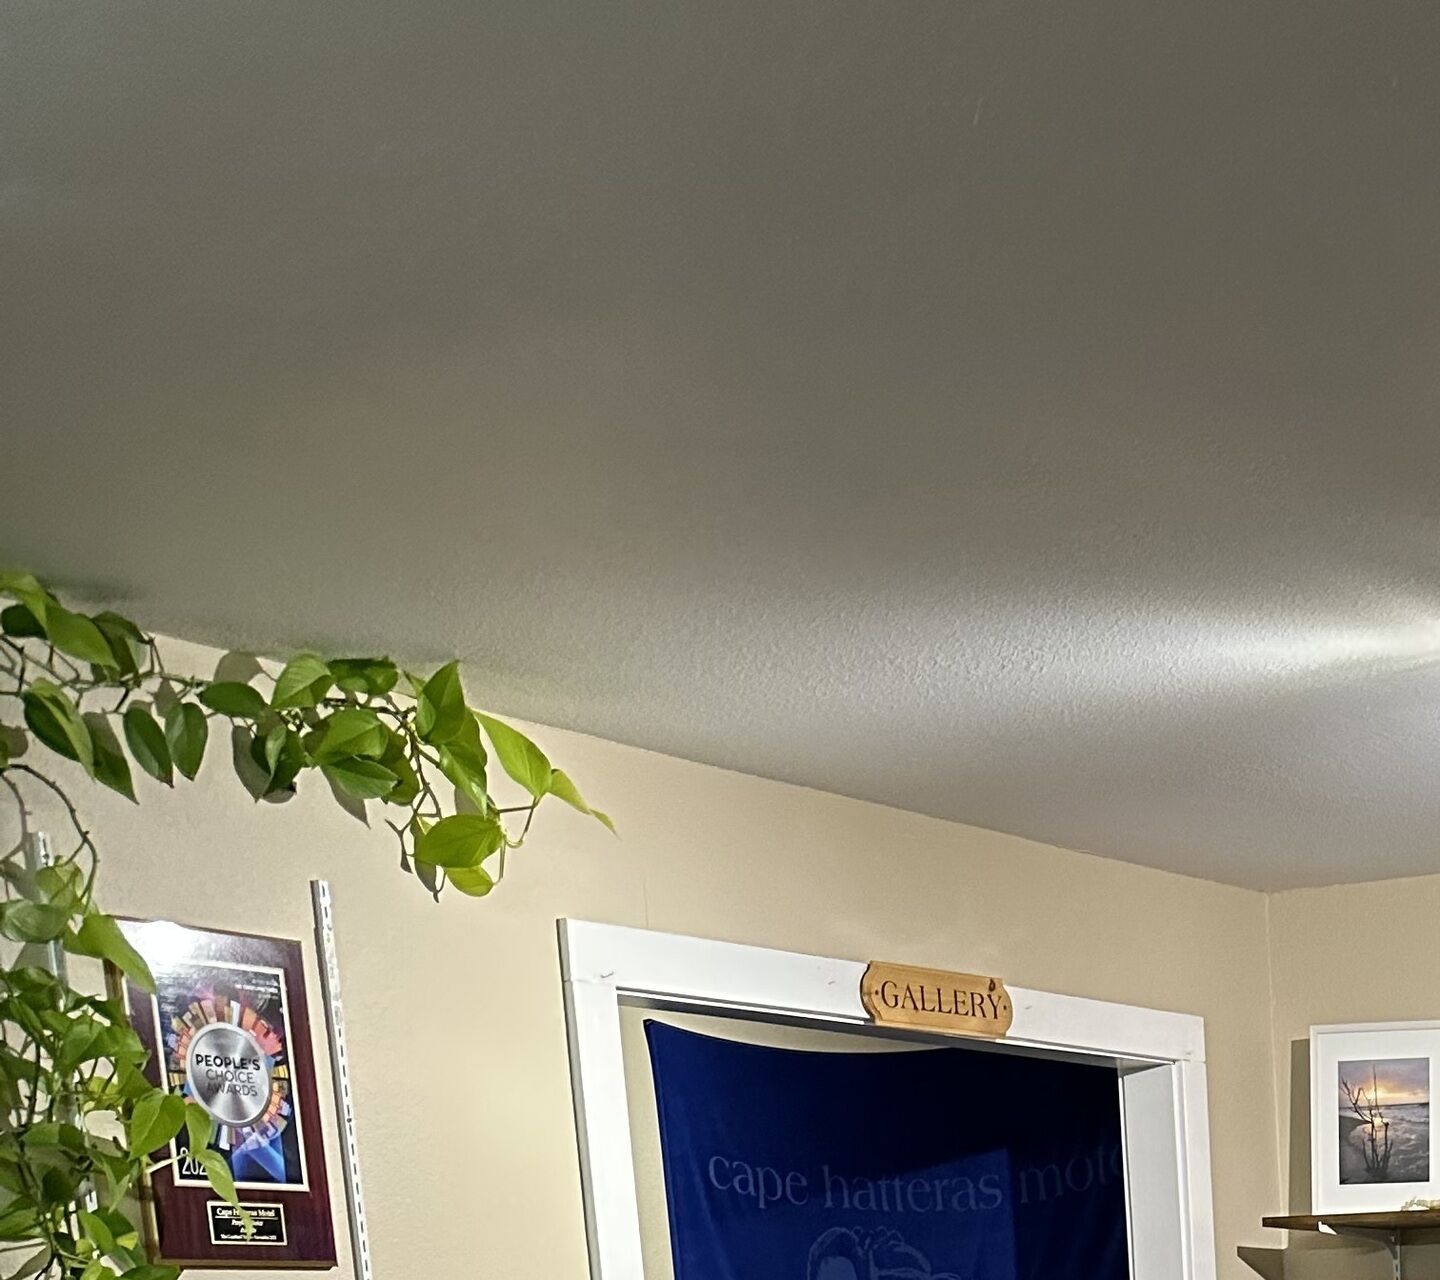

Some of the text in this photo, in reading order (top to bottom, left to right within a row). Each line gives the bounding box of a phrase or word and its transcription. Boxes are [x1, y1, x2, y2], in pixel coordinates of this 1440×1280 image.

[881, 980, 1002, 1020] GALLERY
[195, 1053, 260, 1071] PEOPLE'S
[205, 1068, 255, 1084] CHOICE
[207, 1082, 258, 1097] AWARDS
[707, 1154, 808, 1209] cape
[823, 1163, 1003, 1214] hatteras
